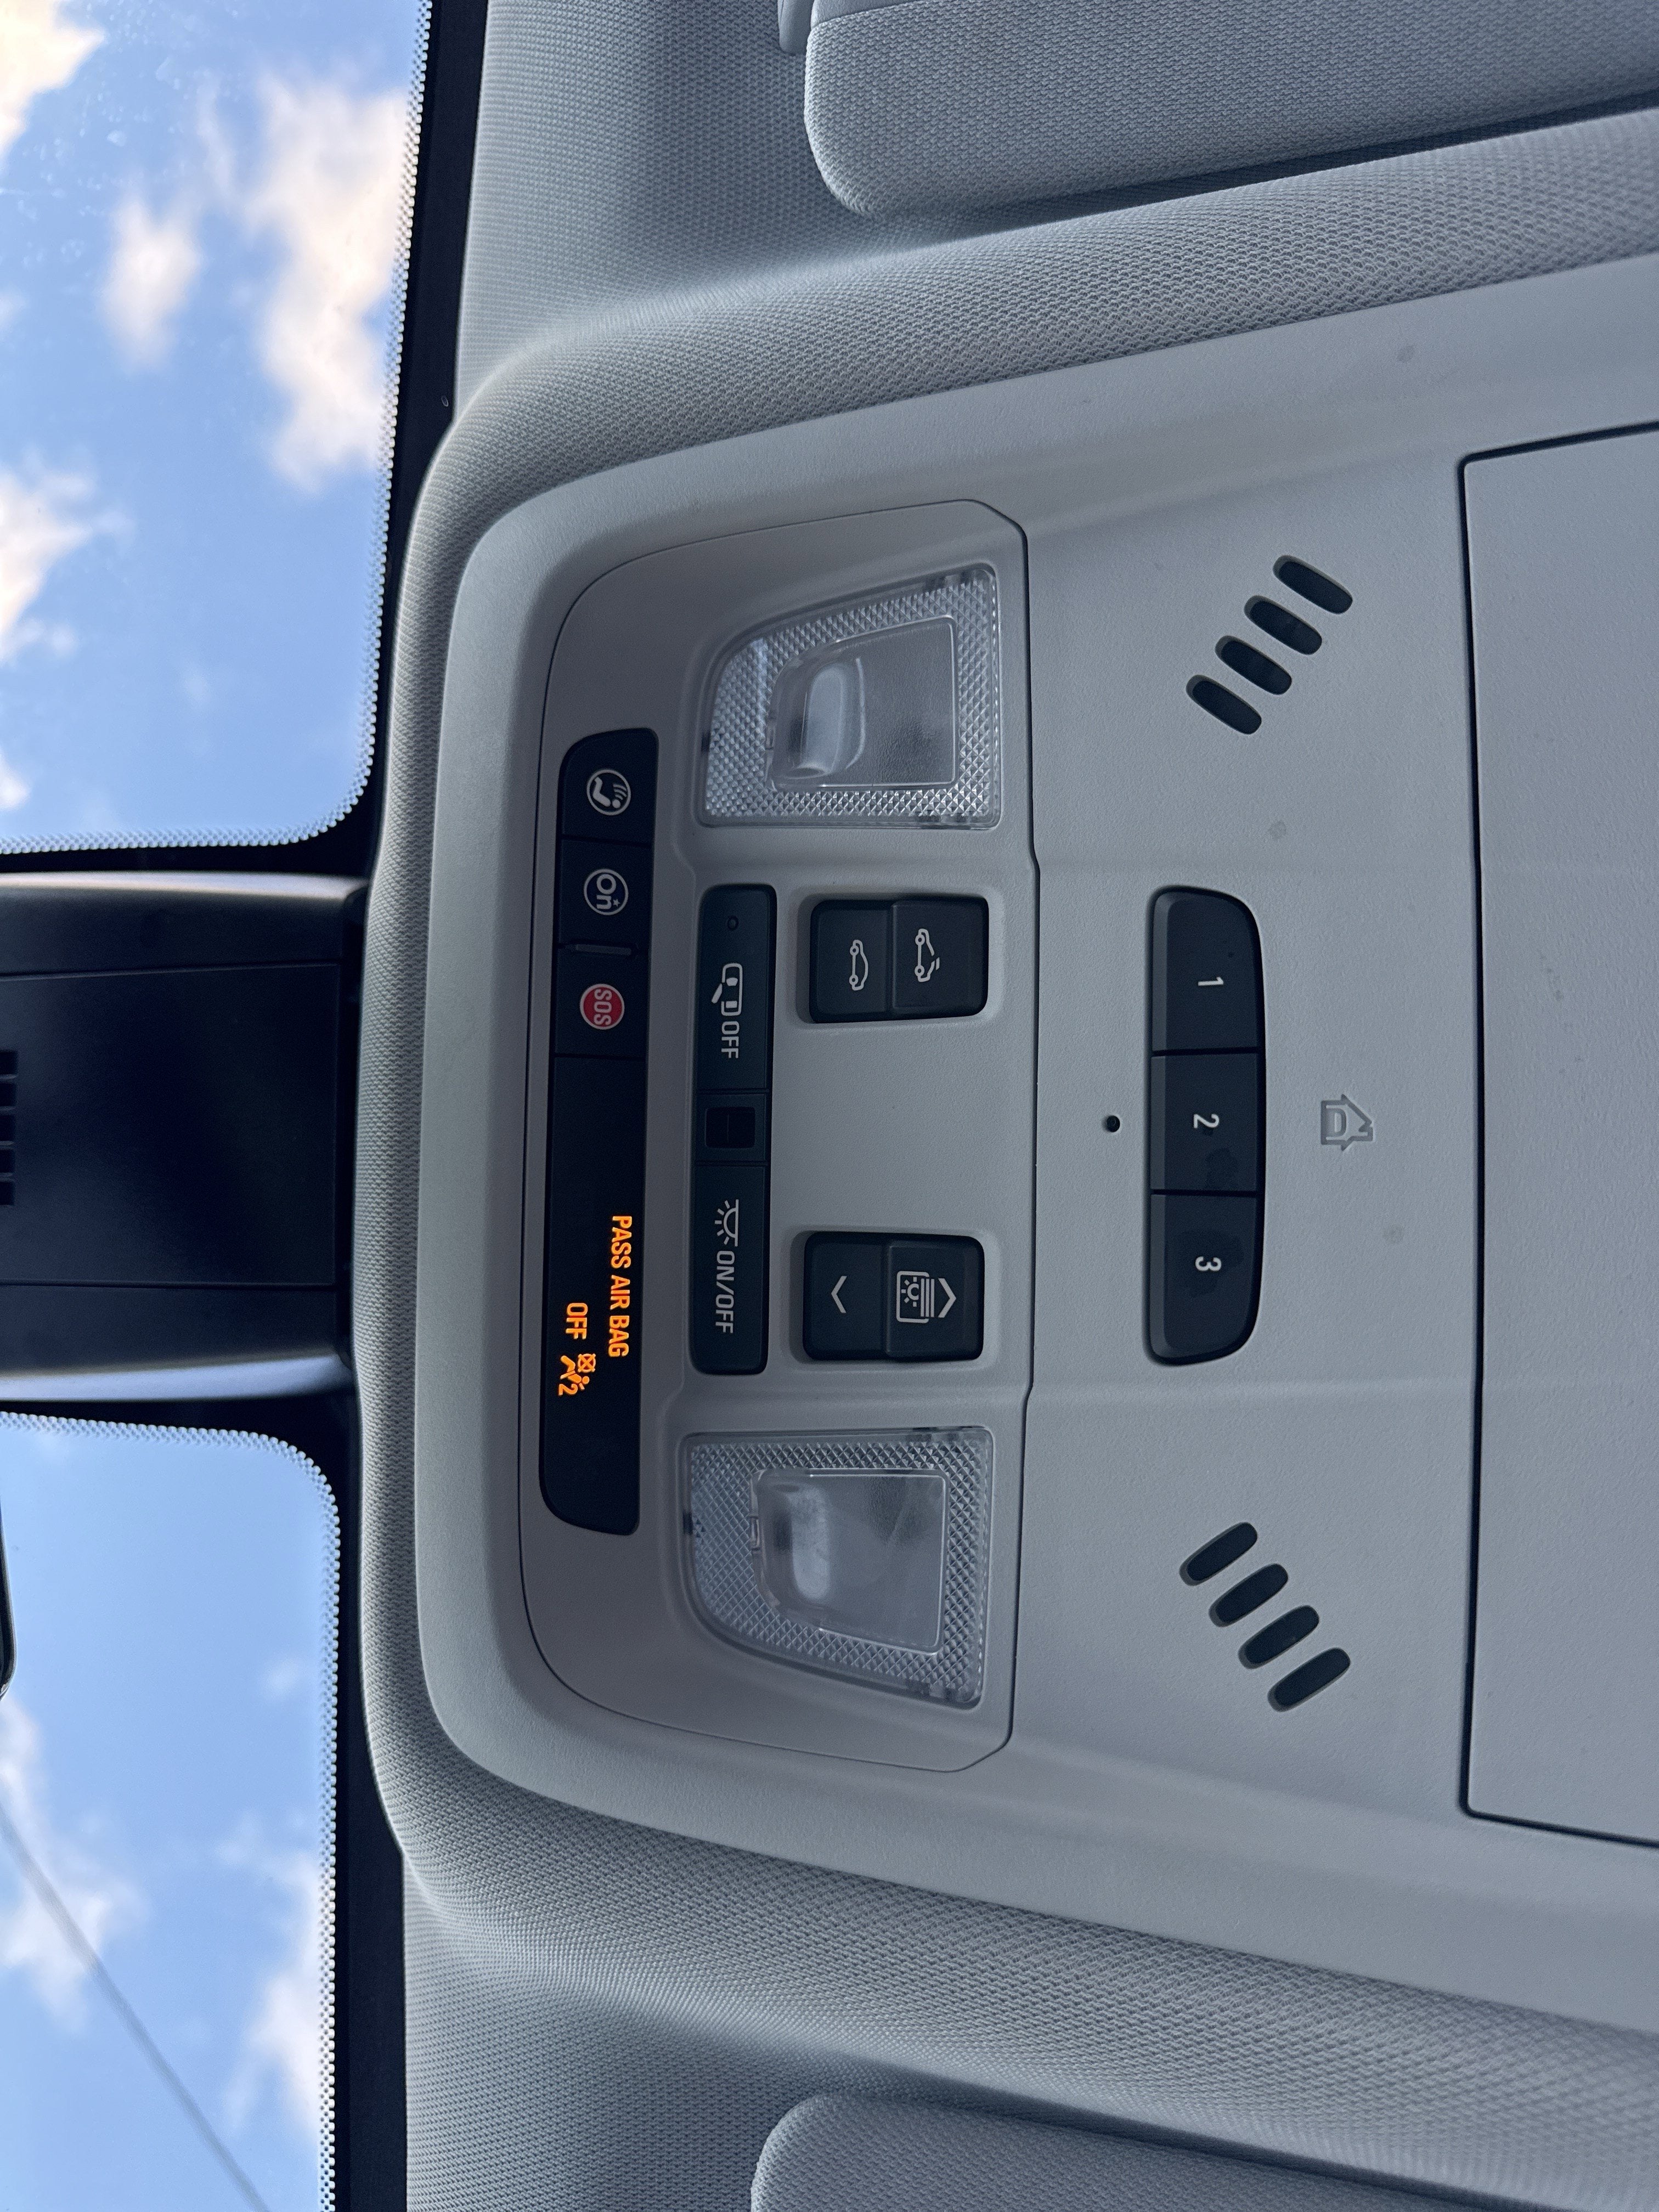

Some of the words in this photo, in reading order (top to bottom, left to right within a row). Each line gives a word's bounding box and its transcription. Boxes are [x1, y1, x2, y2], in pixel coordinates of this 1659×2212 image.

[596, 873, 617, 910] On
[1198, 977, 1224, 986] 1
[594, 988, 612, 1026] SOS
[721, 1020, 740, 1059] OFF
[1193, 1114, 1220, 1128] 2
[611, 1216, 633, 1269] PASS
[1195, 1256, 1222, 1272] 3
[610, 1274, 631, 1310] AIR
[715, 1250, 735, 1334] ON/OFF
[565, 1302, 588, 1340] OFF
[608, 1315, 630, 1357] BAG
